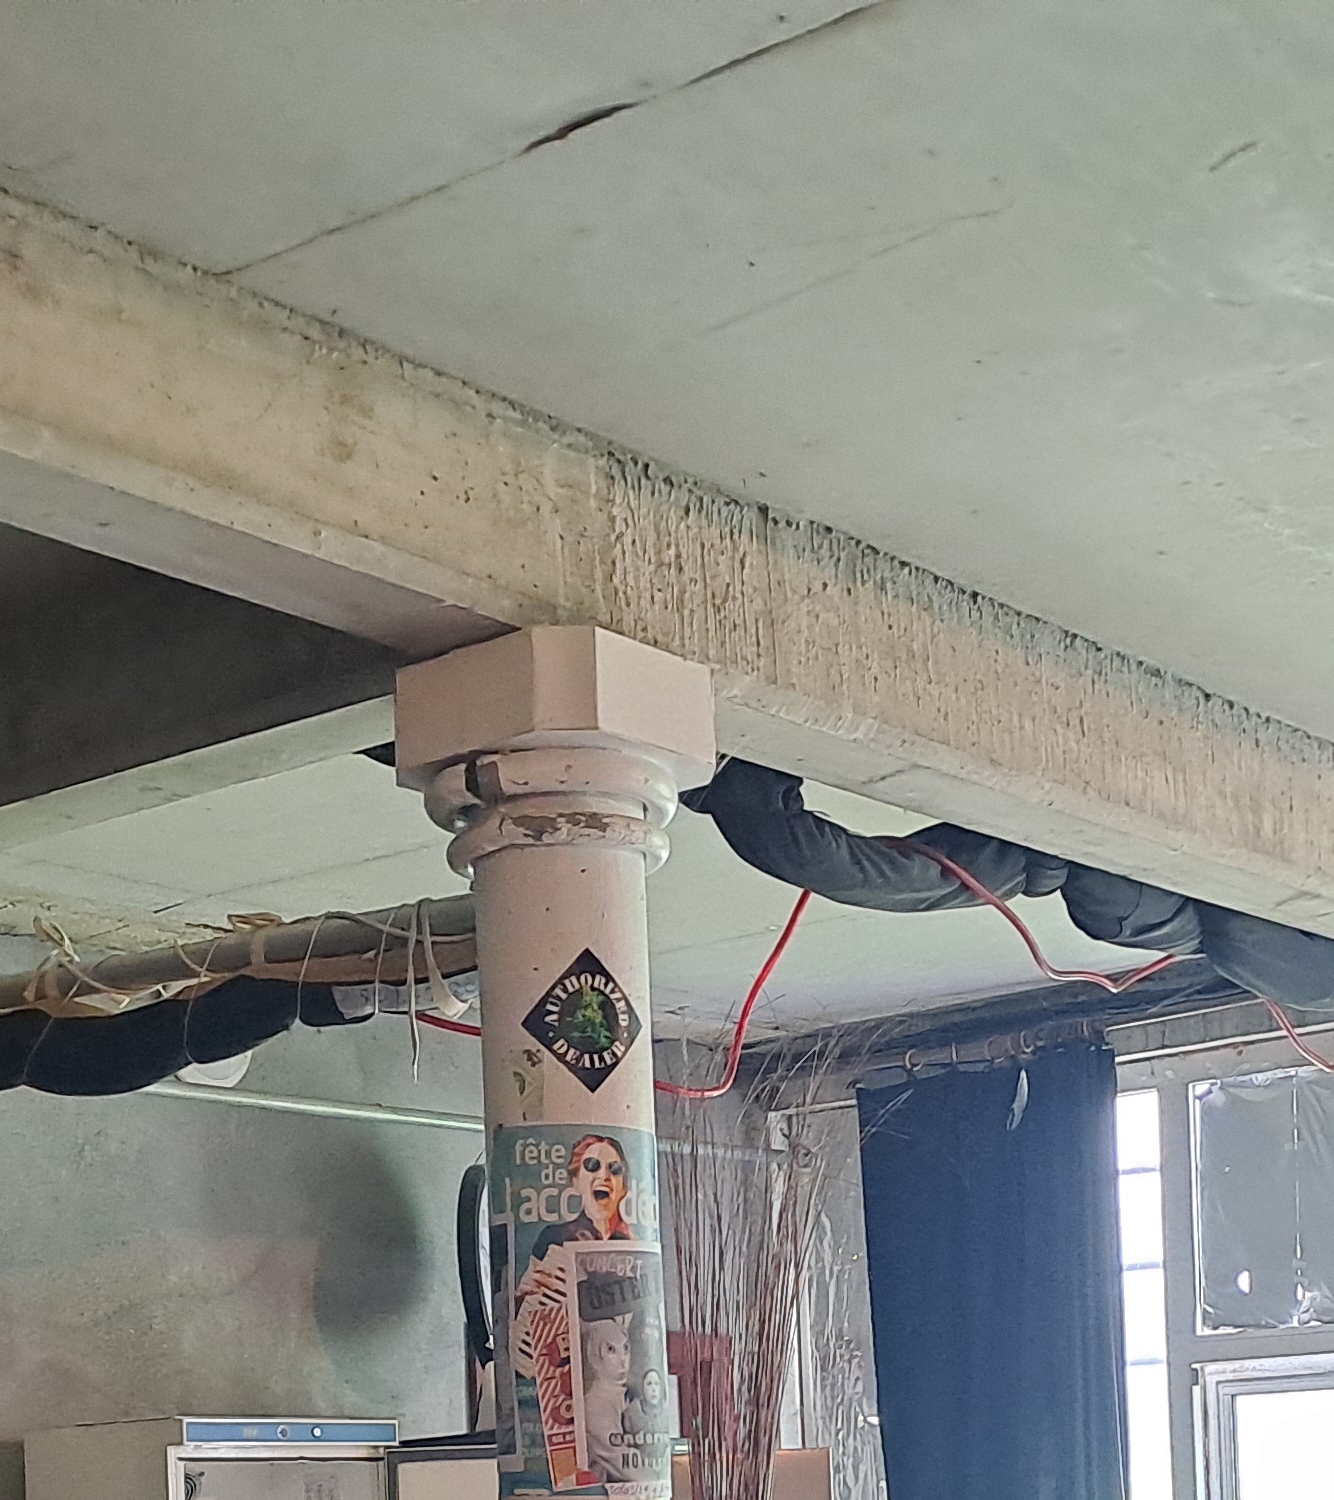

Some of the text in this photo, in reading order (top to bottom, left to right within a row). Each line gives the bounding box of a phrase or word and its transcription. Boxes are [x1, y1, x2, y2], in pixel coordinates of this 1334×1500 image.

[544, 972, 629, 1027] AUTHORIZED
[552, 1037, 626, 1069] DEALER
[515, 1137, 566, 1165] fête
[541, 1164, 566, 1185] de
